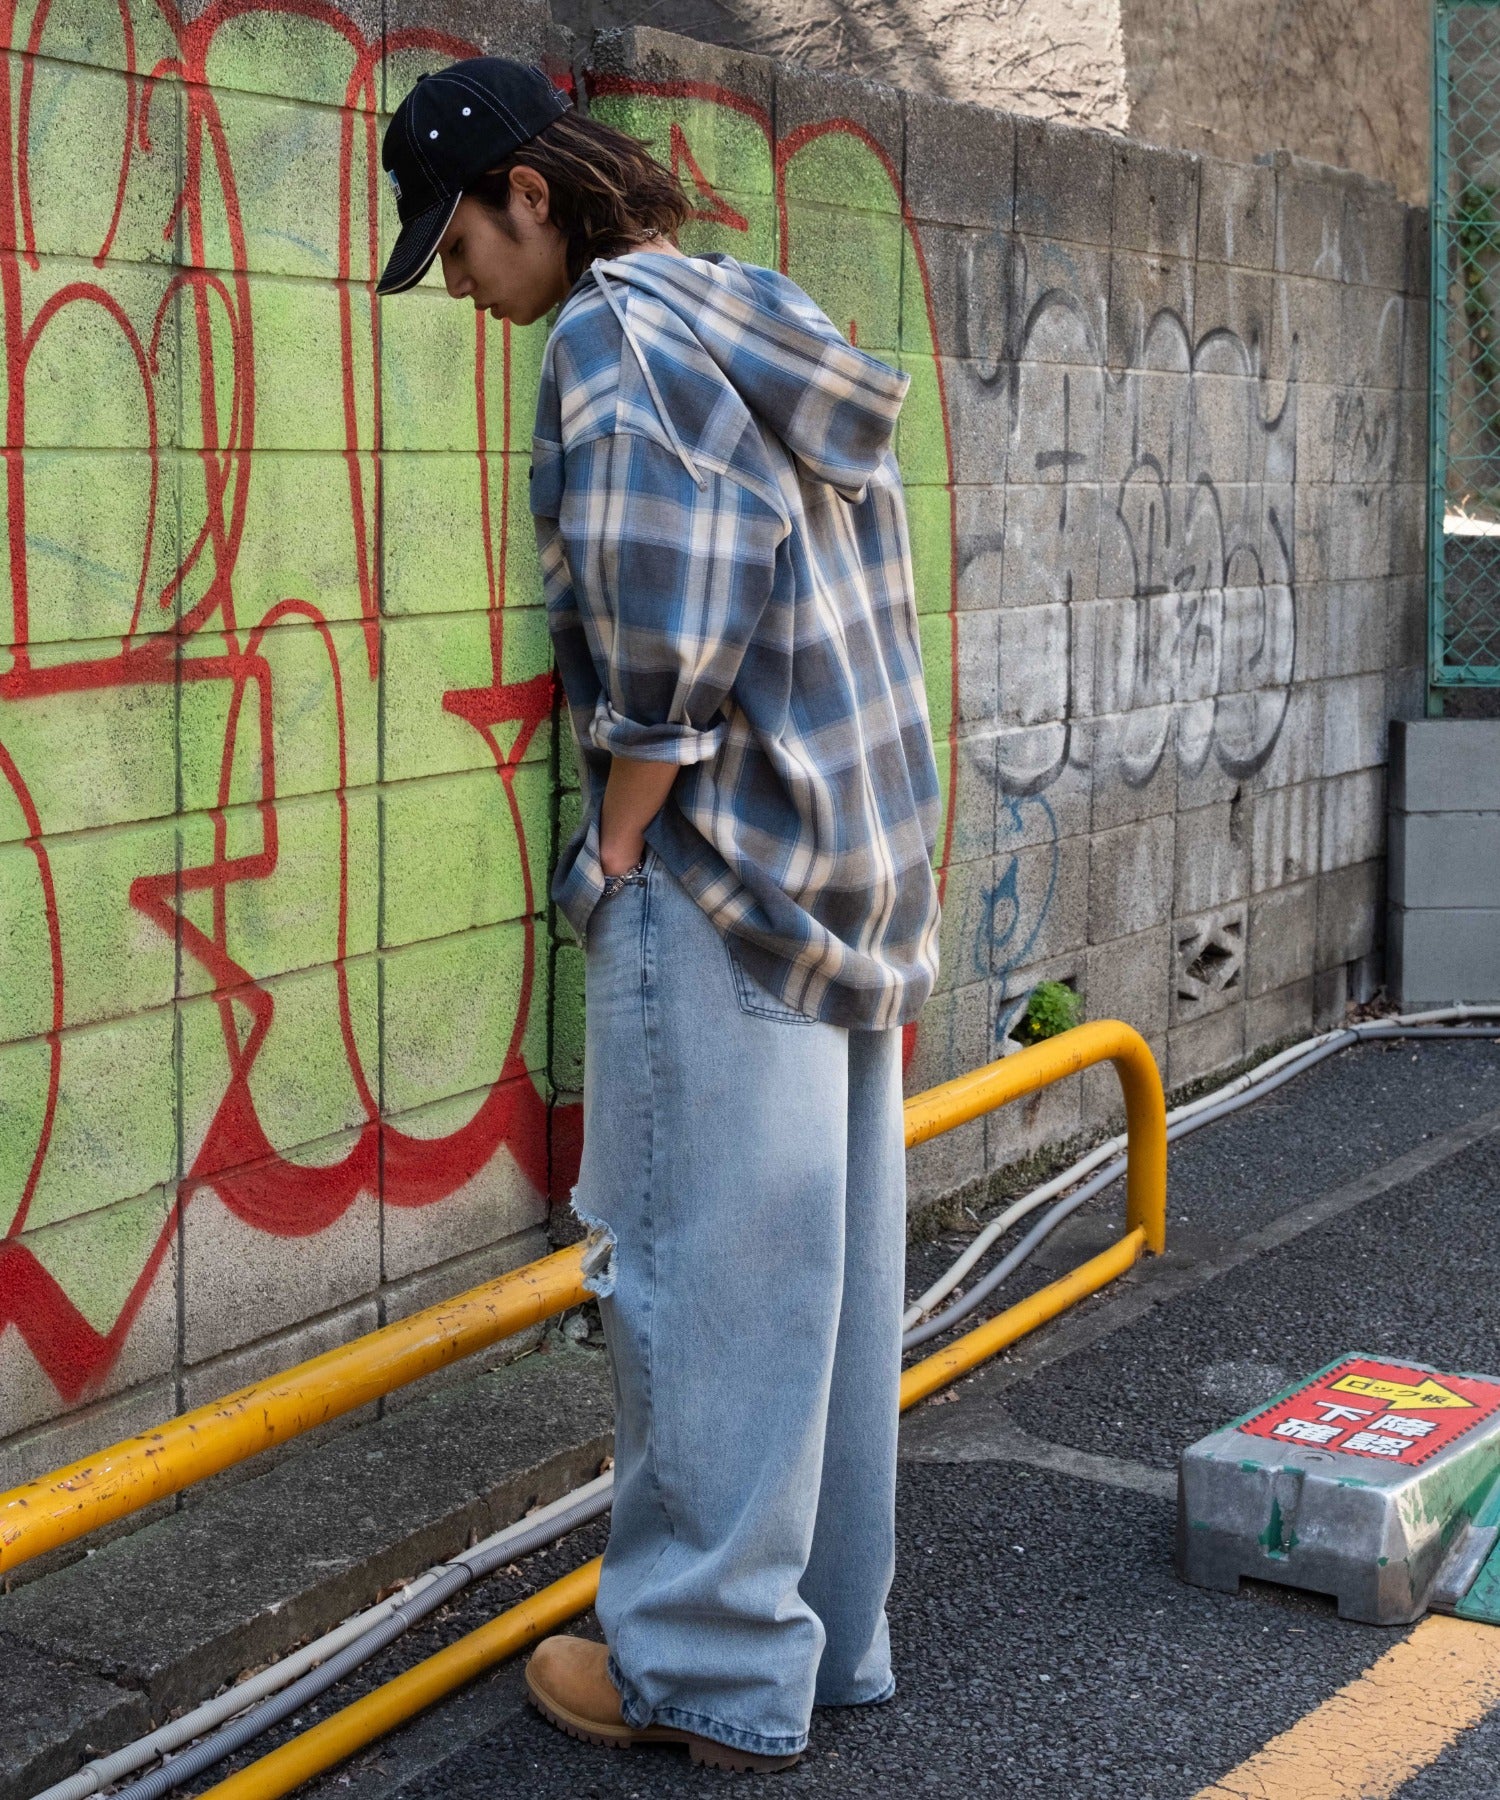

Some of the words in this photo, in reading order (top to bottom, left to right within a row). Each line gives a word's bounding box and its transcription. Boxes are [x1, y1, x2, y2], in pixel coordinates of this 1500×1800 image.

[1346, 1380, 1451, 1404] ロック板
[1272, 1417, 1415, 1456] 確認
[1315, 1401, 1439, 1437] 下降
